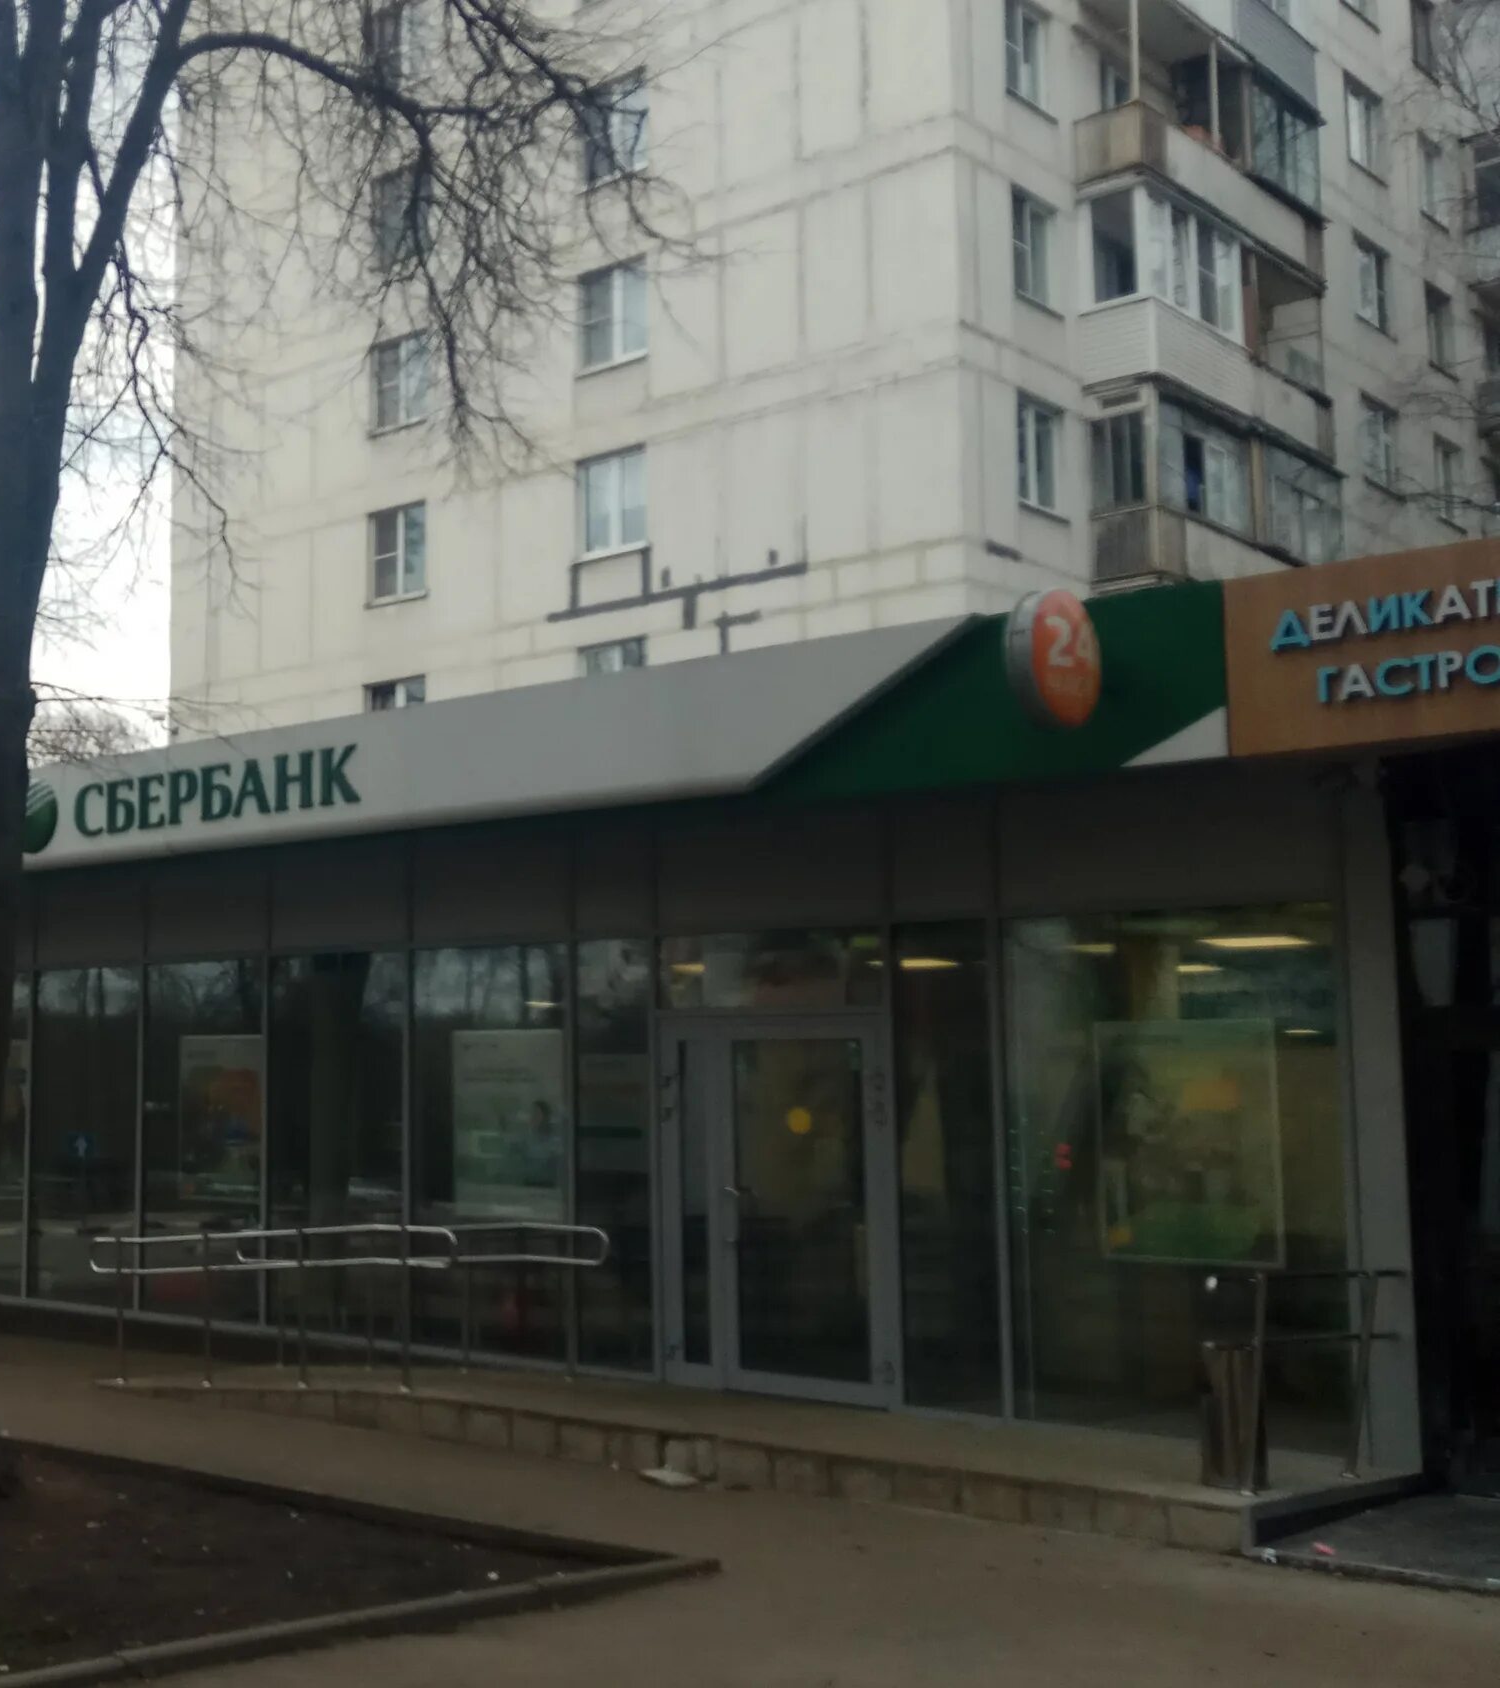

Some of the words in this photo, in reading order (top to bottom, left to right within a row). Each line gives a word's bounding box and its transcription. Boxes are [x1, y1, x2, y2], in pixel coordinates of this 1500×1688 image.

[1269, 577, 1500, 652] ДЕЛИКАТ
[1316, 643, 1500, 703] ГАСТРО
[74, 743, 362, 837] СБЕРБАНК
